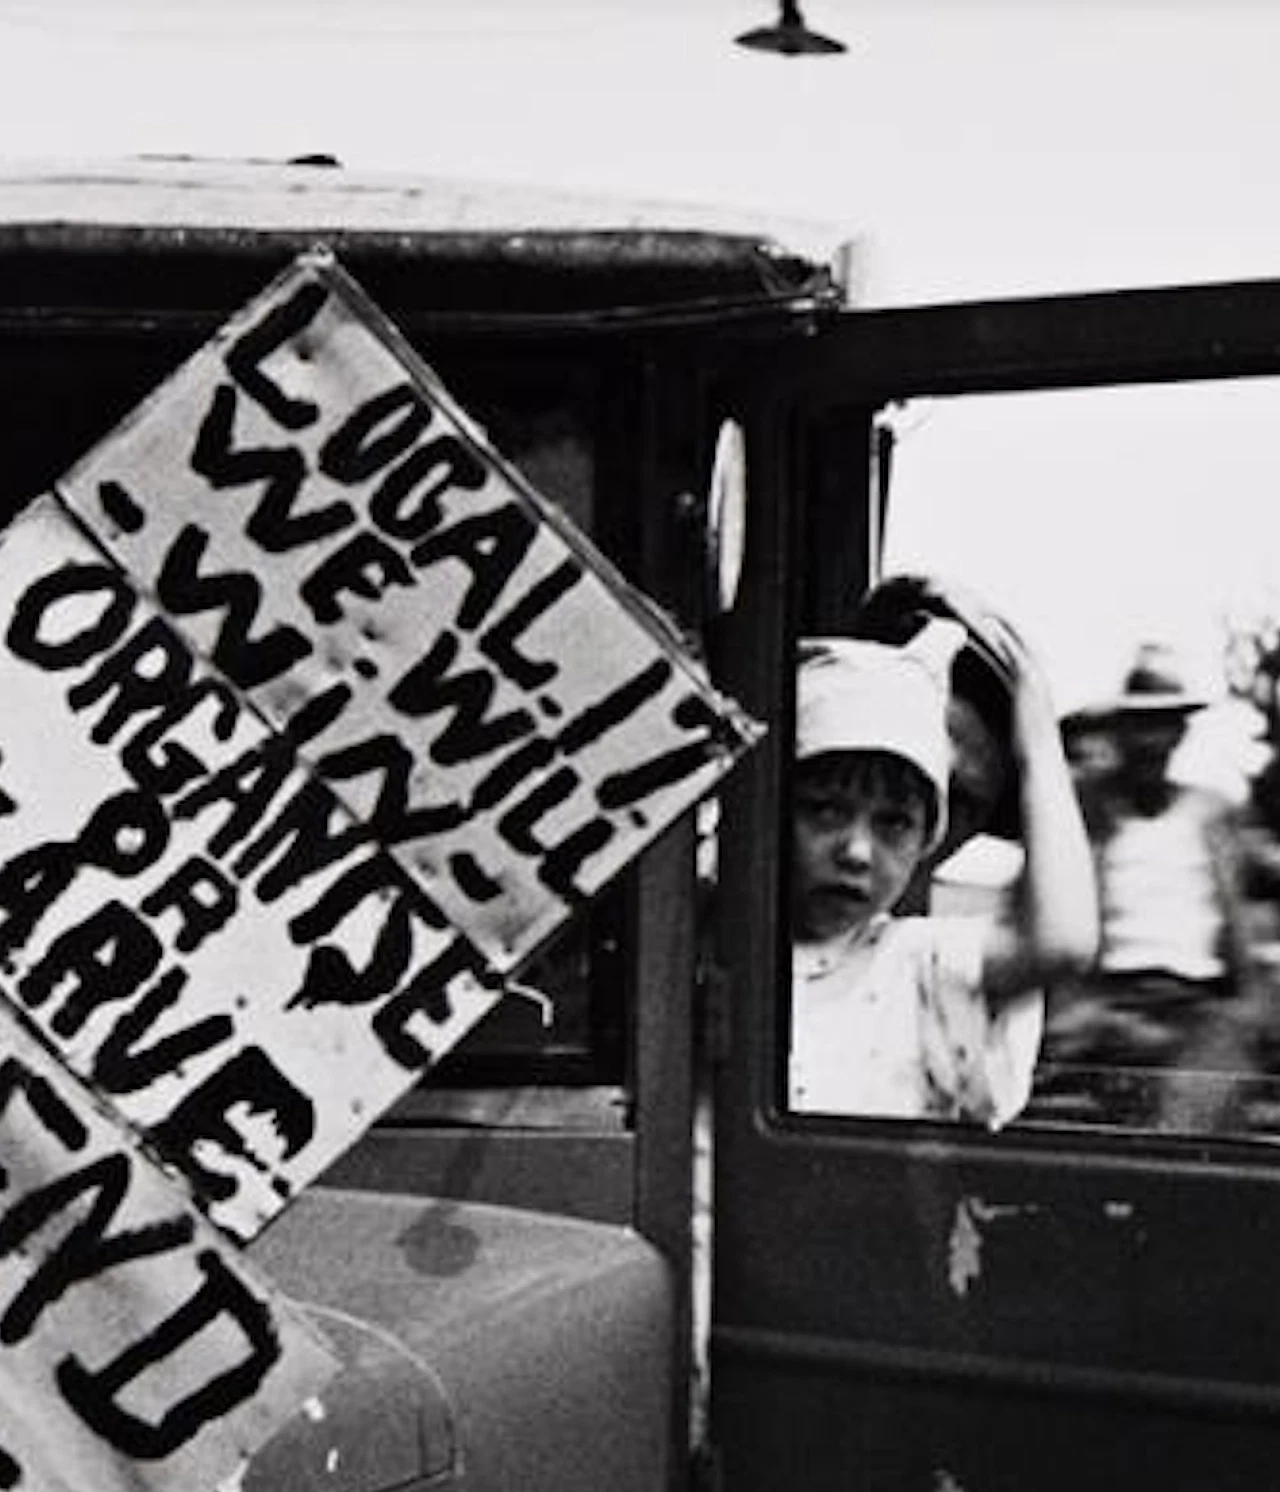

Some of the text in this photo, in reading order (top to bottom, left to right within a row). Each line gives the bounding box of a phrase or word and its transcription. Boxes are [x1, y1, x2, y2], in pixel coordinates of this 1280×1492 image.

[5, 560, 505, 1070] ORGANISE
[82, 789, 238, 954] OR
[388, 631, 615, 895] WILL
